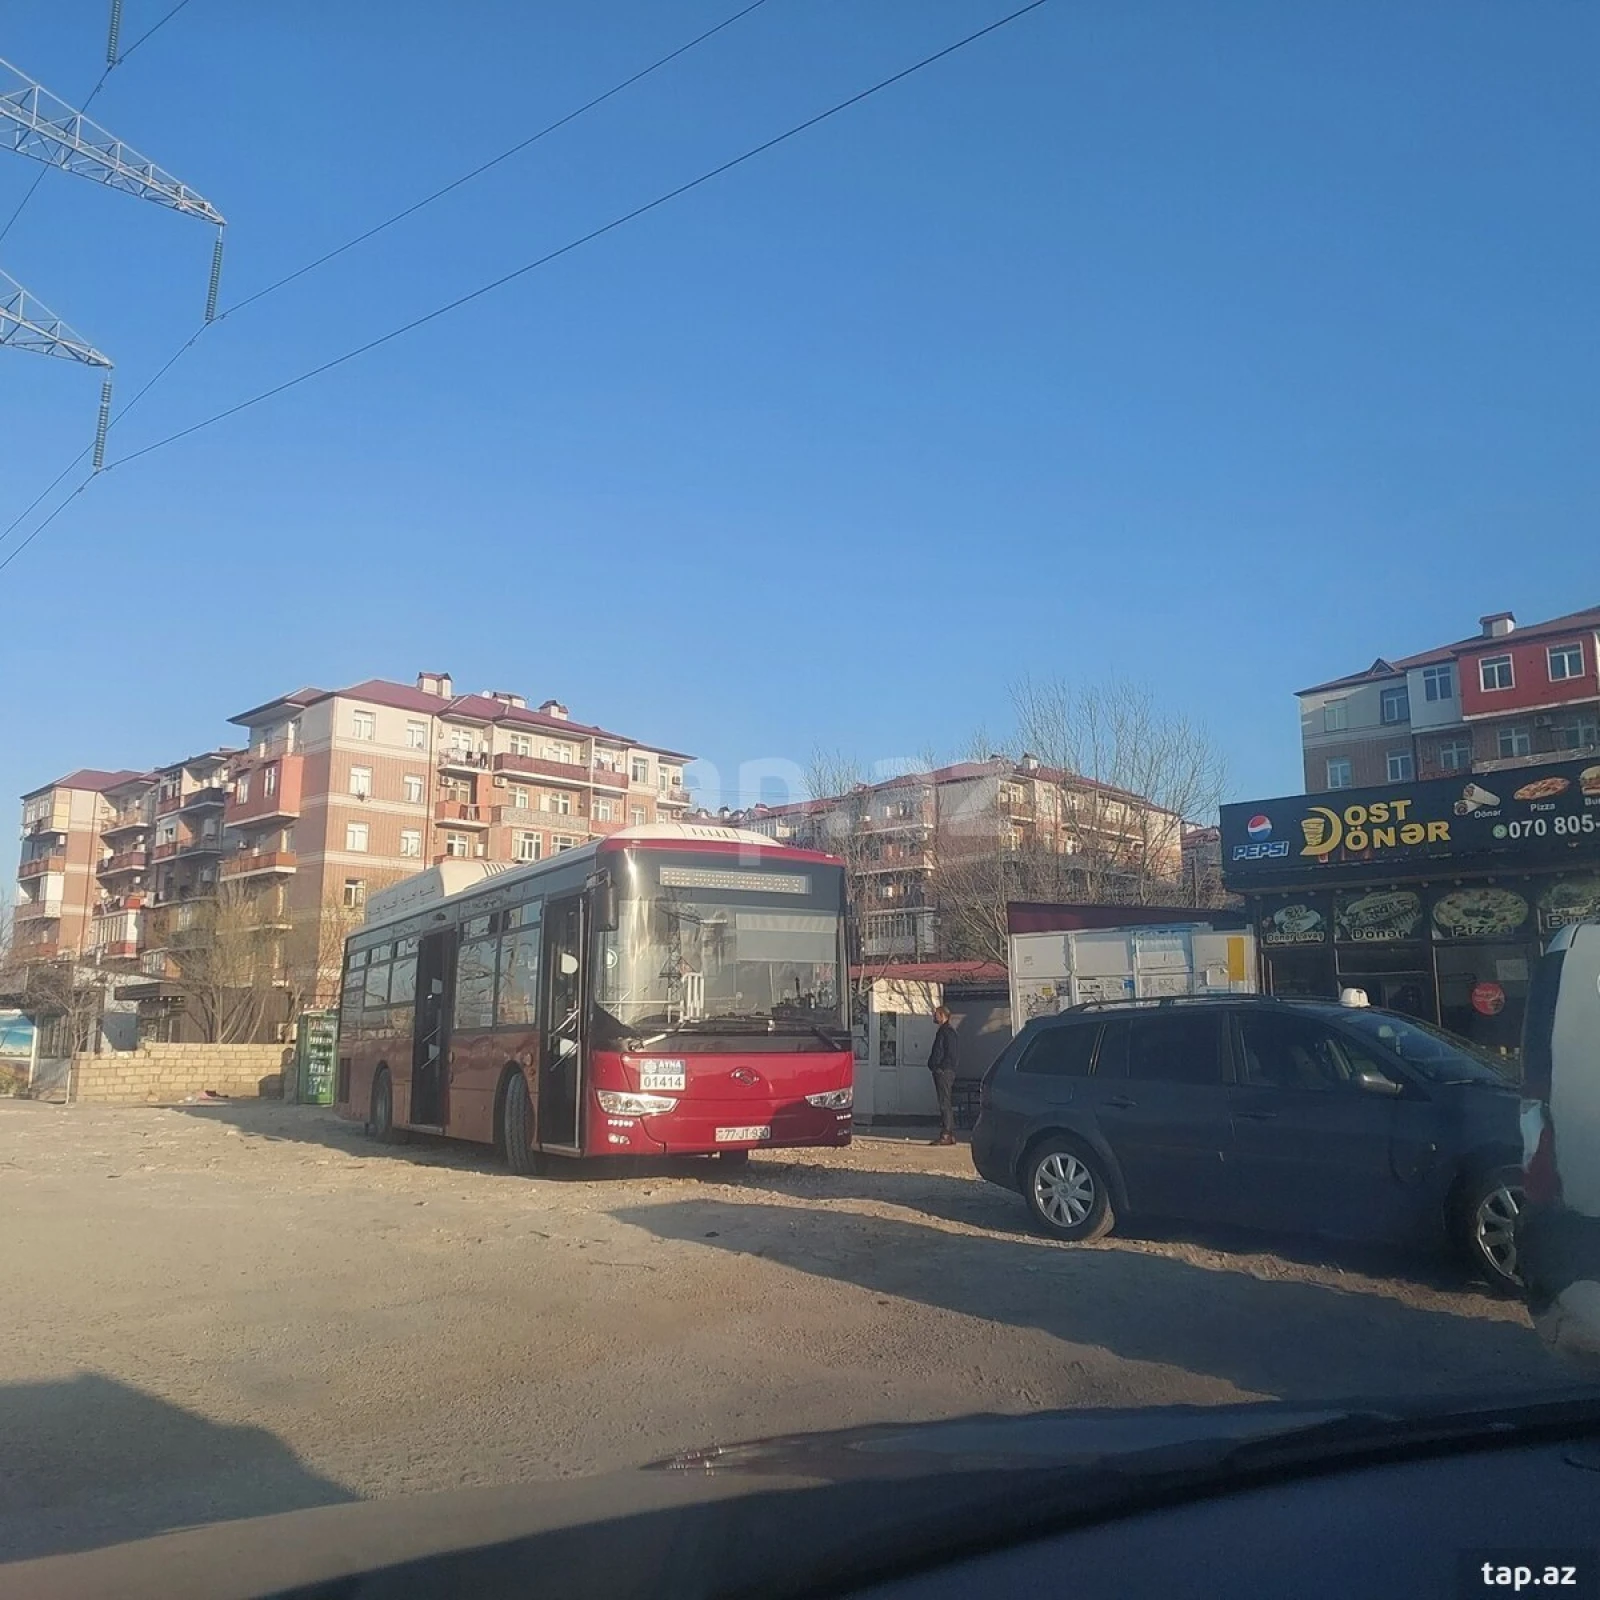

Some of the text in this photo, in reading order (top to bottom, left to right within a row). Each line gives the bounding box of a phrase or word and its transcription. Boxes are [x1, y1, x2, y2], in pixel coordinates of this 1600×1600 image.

[1530, 803, 1556, 812] Pizza
[1508, 819, 1547, 838] 070
[1232, 841, 1290, 861] PEPSI
[644, 1076, 682, 1088] 01414
